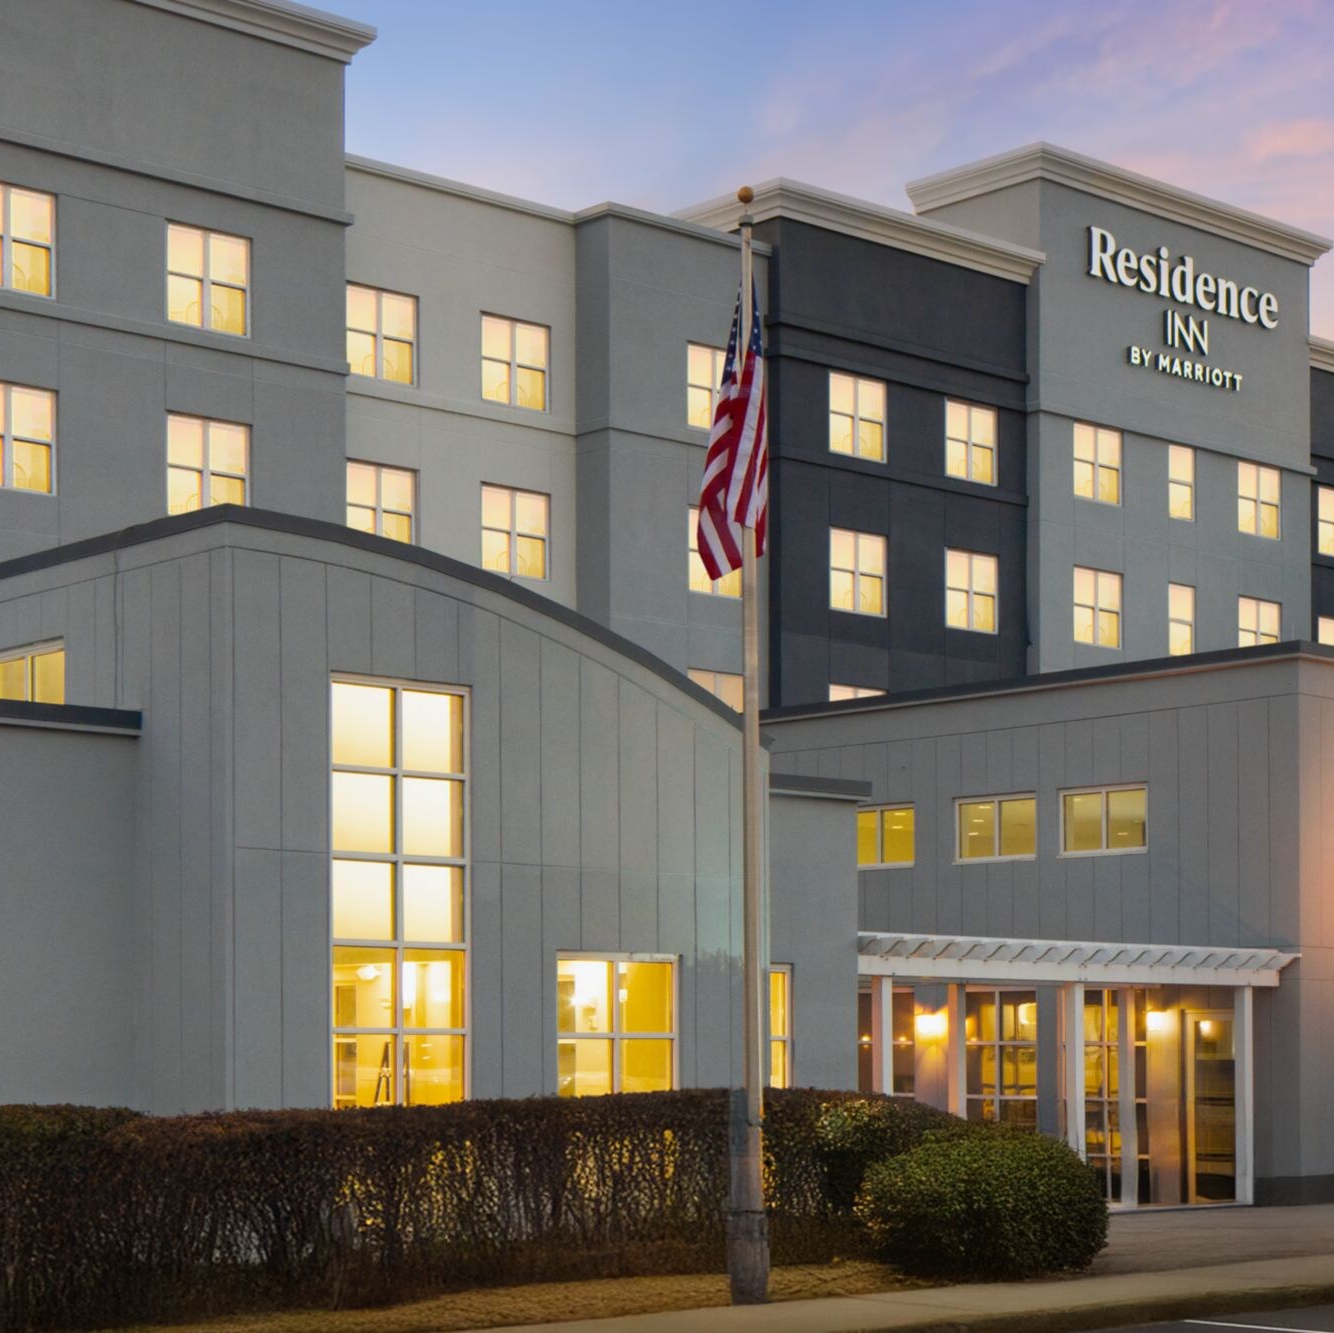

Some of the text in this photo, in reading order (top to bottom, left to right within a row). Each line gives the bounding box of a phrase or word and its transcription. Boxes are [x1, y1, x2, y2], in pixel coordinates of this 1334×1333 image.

[1087, 225, 1279, 329] Residence
[1165, 309, 1209, 355] INN
[1129, 346, 1243, 391] BY MARRIOTT
